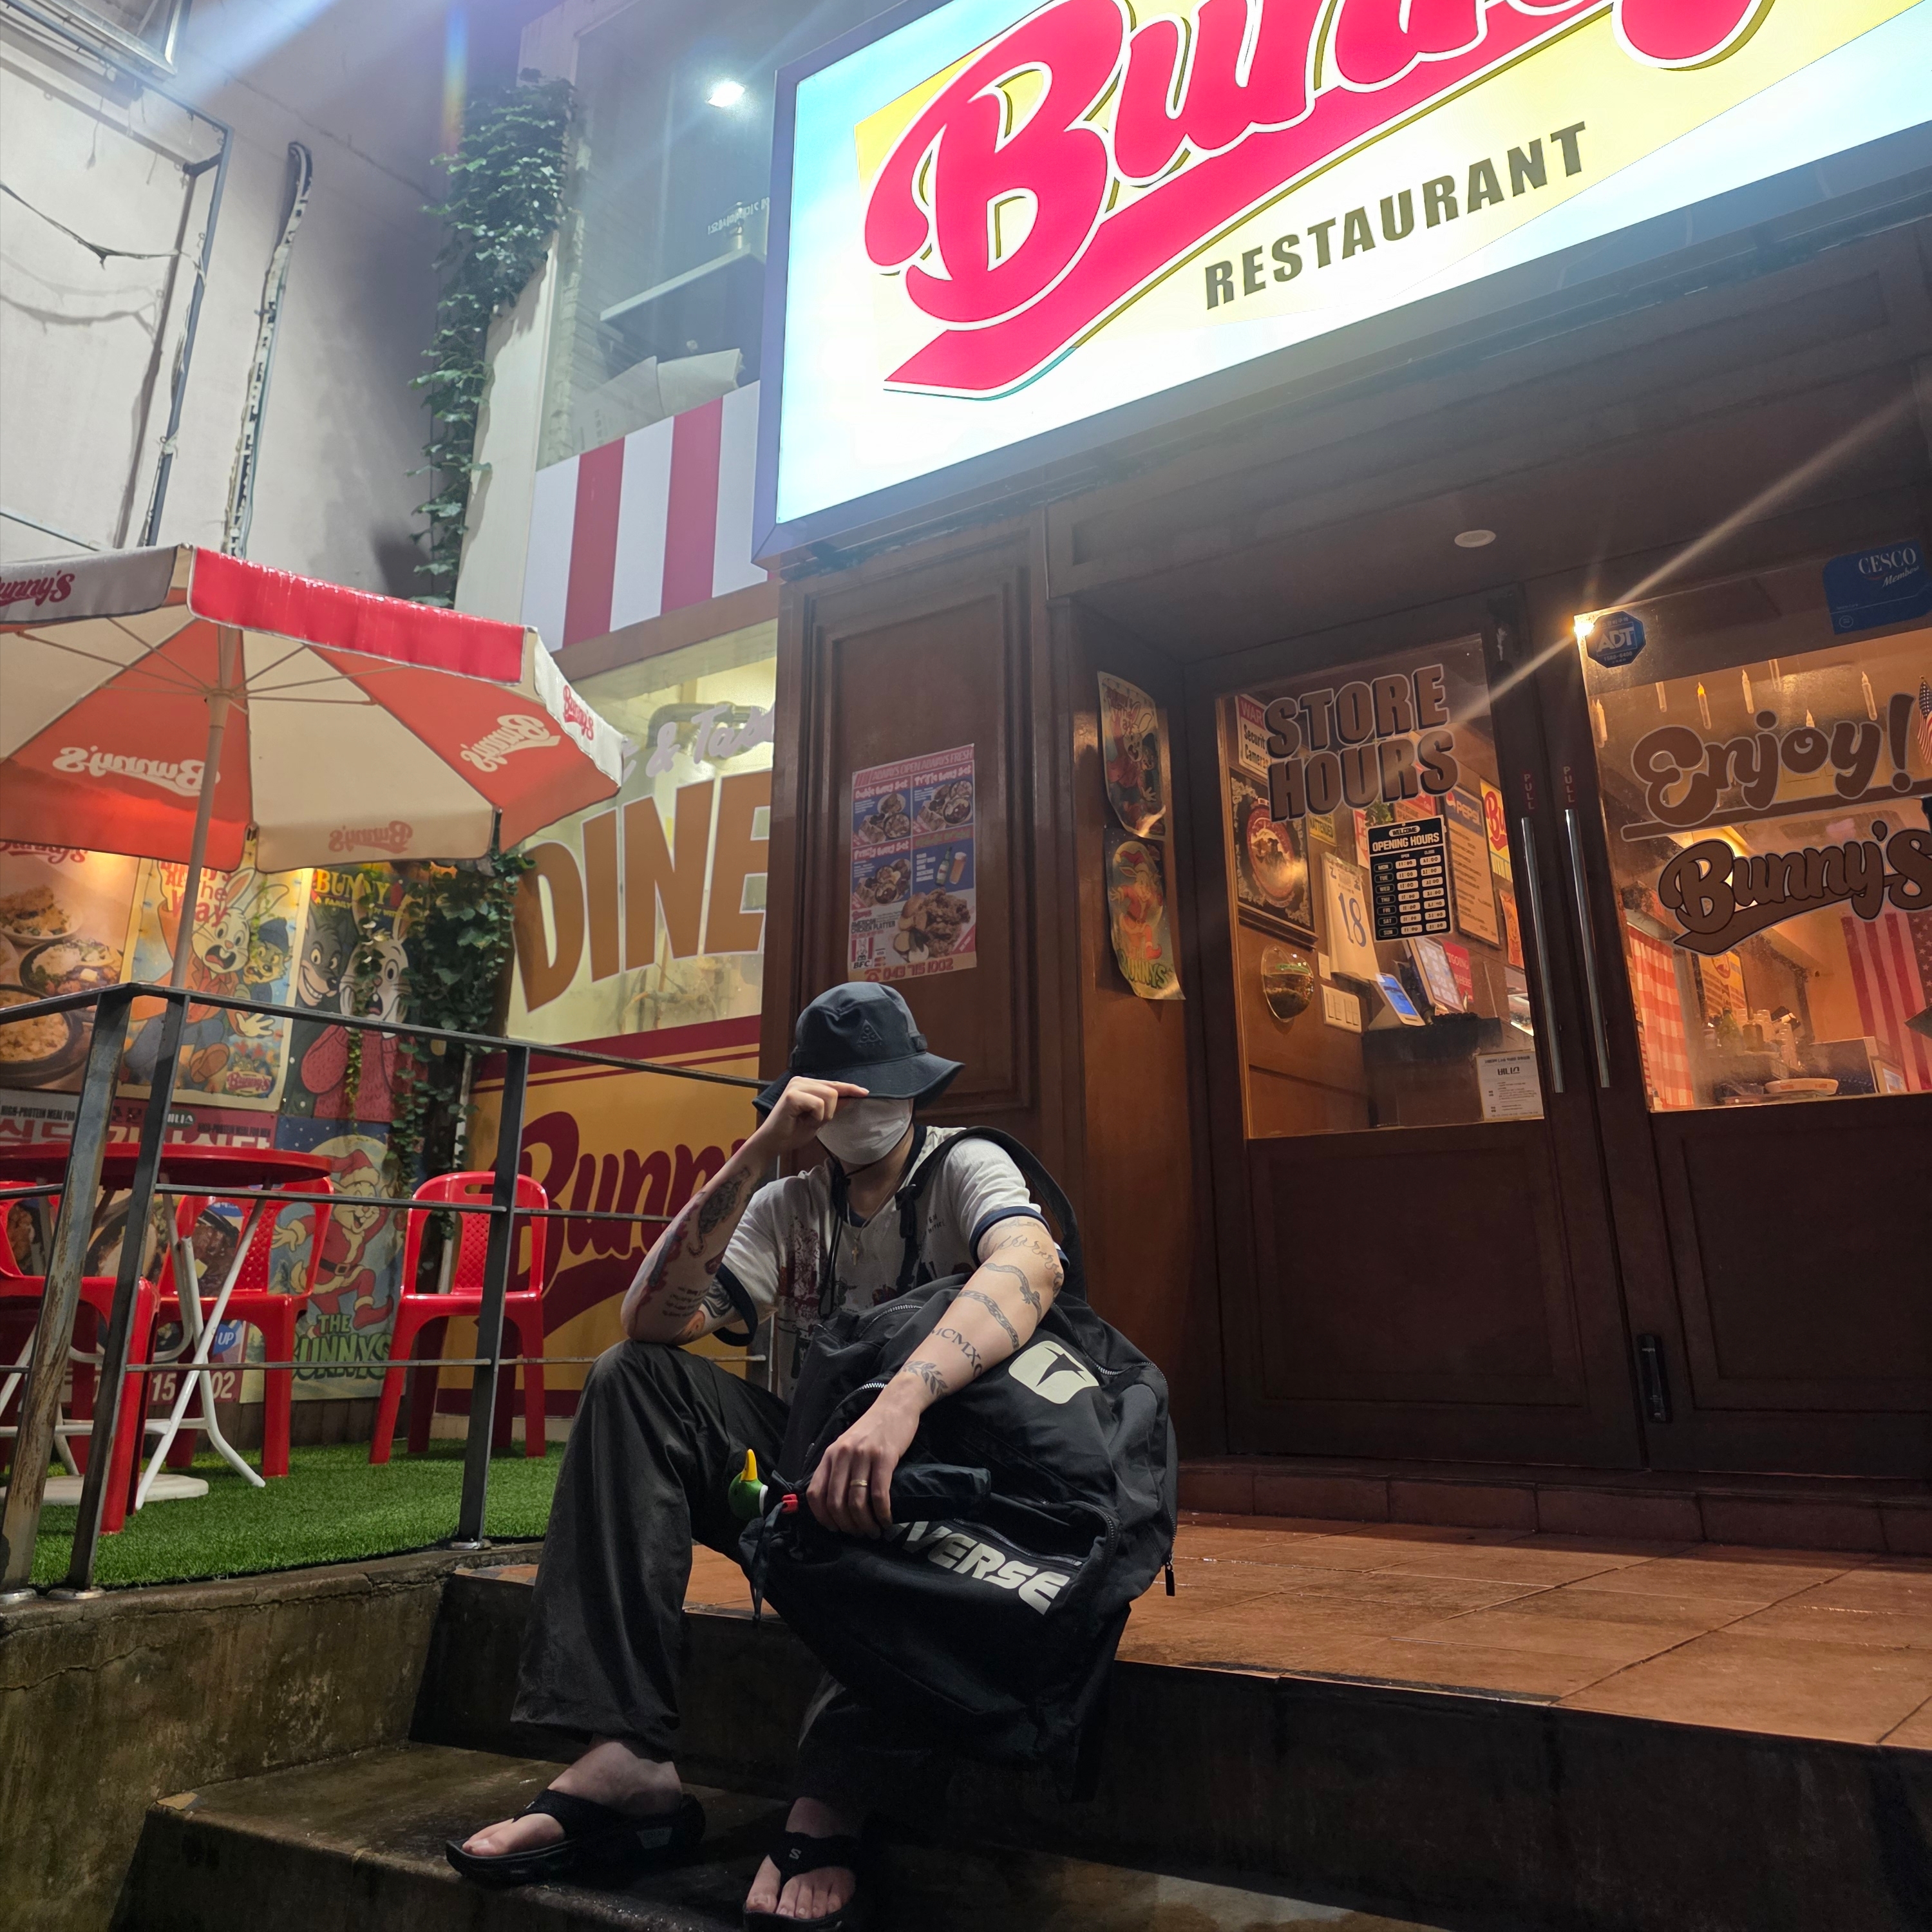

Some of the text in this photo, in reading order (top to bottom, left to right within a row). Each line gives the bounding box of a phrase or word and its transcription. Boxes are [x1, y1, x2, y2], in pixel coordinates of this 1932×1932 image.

[1205, 121, 1587, 310] RESTAURANT
[1858, 547, 1917, 575] CESCO
[0, 569, 75, 607] unny's
[1597, 625, 1635, 653] ADT
[1239, 699, 1264, 726] WAR
[1265, 664, 1451, 760] STORE
[645, 721, 681, 778] &
[691, 703, 773, 765] Tas
[1244, 723, 1266, 750] Securit
[1267, 730, 1459, 823] HOURS
[1631, 692, 1917, 828] Enjoy!
[1524, 773, 1535, 810] PULL
[1563, 766, 1576, 803] PULL
[1372, 832, 1439, 852] OPENING HOURS
[1392, 826, 1417, 836] WELCOME
[511, 769, 770, 1016] DINE
[1658, 820, 1932, 958] Bunny's
[1338, 892, 1367, 948] 18
[883, 957, 954, 980] 043 715 1002
[1, 1105, 46, 1119] HIGH-PROTEIN
[46, 1108, 63, 1120] MEAL
[478, 1111, 748, 1340] Bunn
[316, 1314, 352, 1333] THE
[293, 1332, 392, 1381] UNNYS
[154, 1372, 178, 1403] 15
[882, 1520, 1070, 1616] VERSE
